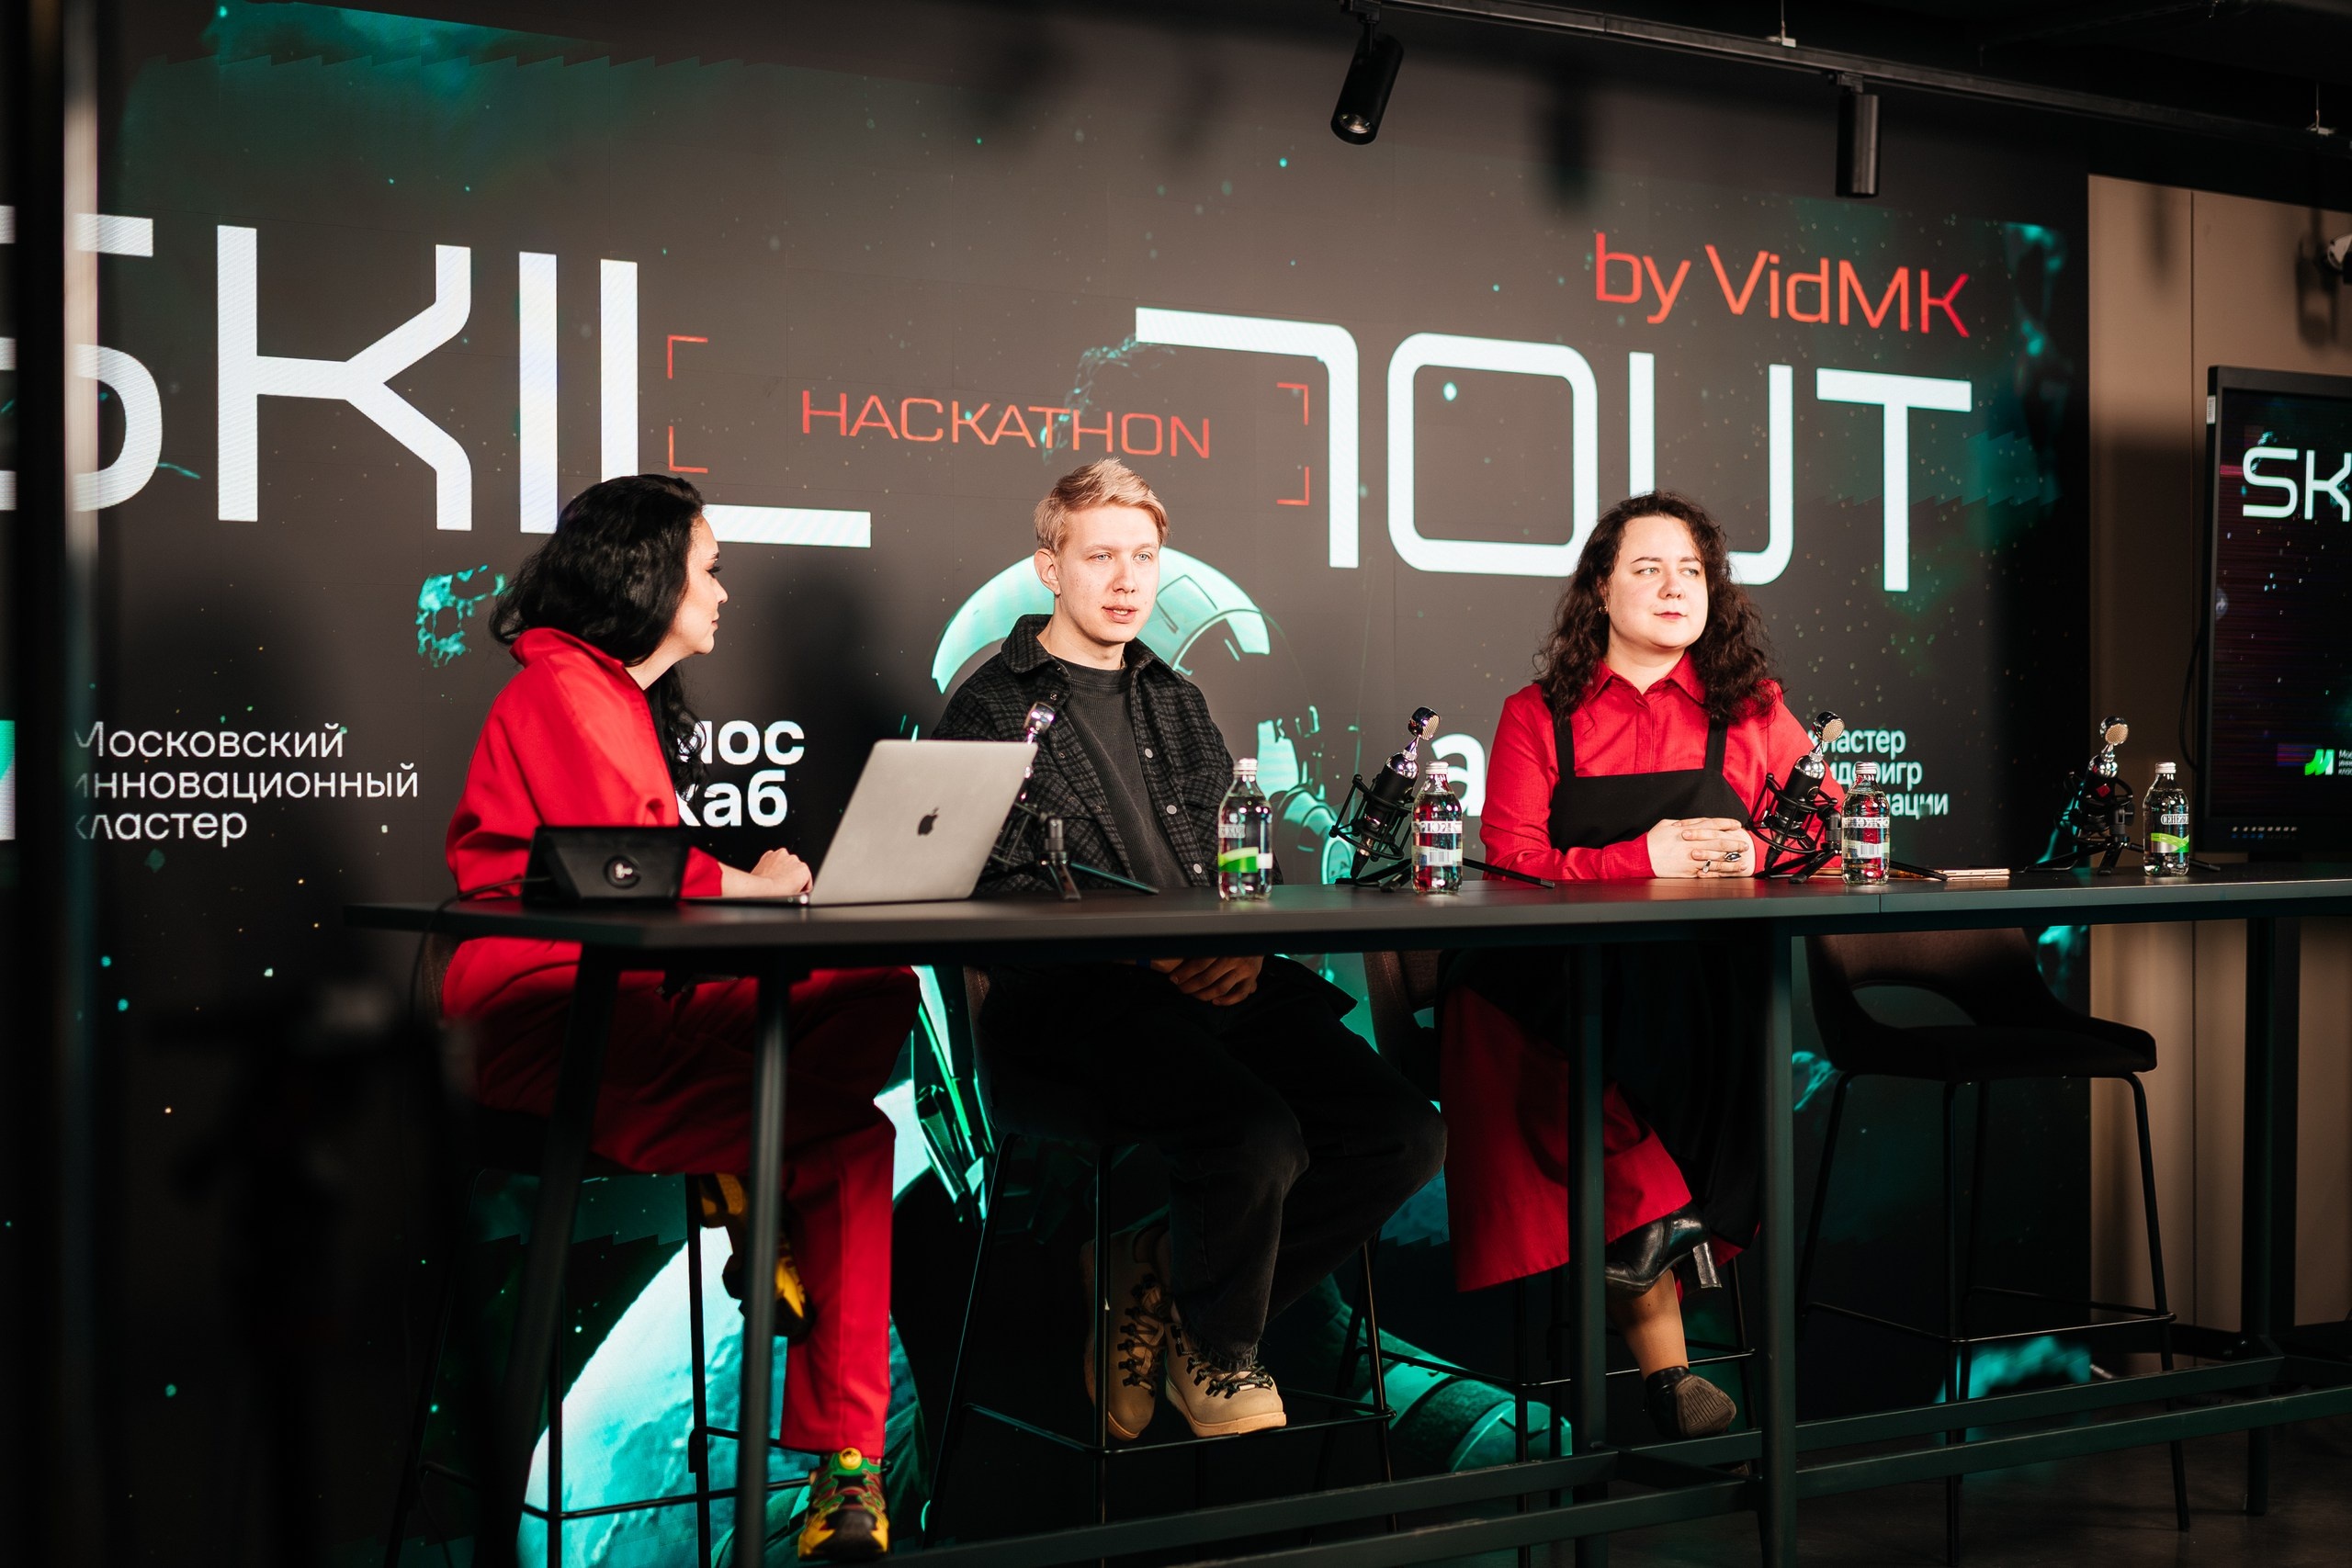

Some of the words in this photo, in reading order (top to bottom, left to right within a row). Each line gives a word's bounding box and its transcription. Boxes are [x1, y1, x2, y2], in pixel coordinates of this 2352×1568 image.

[1595, 232, 1690, 324] by
[1704, 243, 1970, 338] VidMK
[802, 390, 1210, 458] HACKATHON
[1807, 729, 1906, 761] астер
